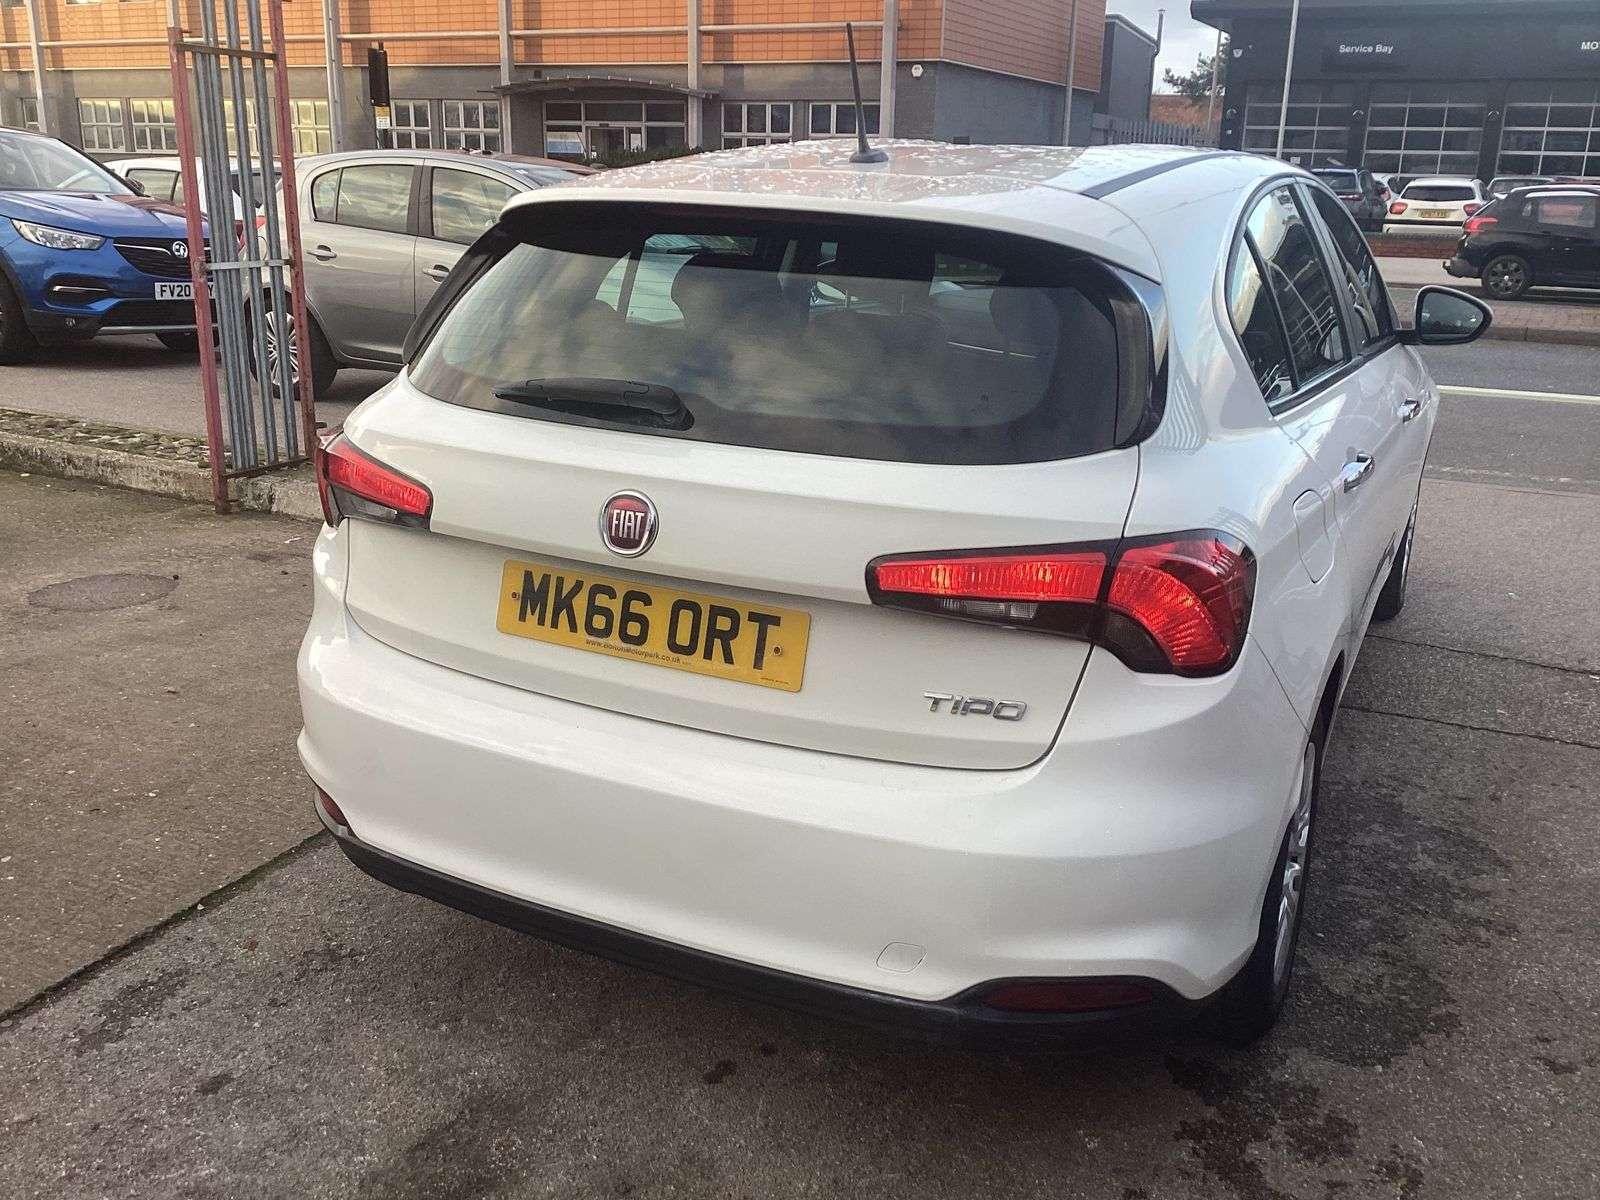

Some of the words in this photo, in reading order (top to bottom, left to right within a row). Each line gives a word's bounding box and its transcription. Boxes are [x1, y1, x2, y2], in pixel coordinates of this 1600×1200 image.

[1338, 44, 1374, 53] Service
[1375, 44, 1394, 54] Bay
[1581, 41, 1600, 50] MO
[160, 283, 191, 298] FV20
[611, 508, 645, 540] FIAT
[518, 569, 653, 647] MK66
[667, 598, 782, 671] ORT
[923, 691, 1027, 721] TIPO
